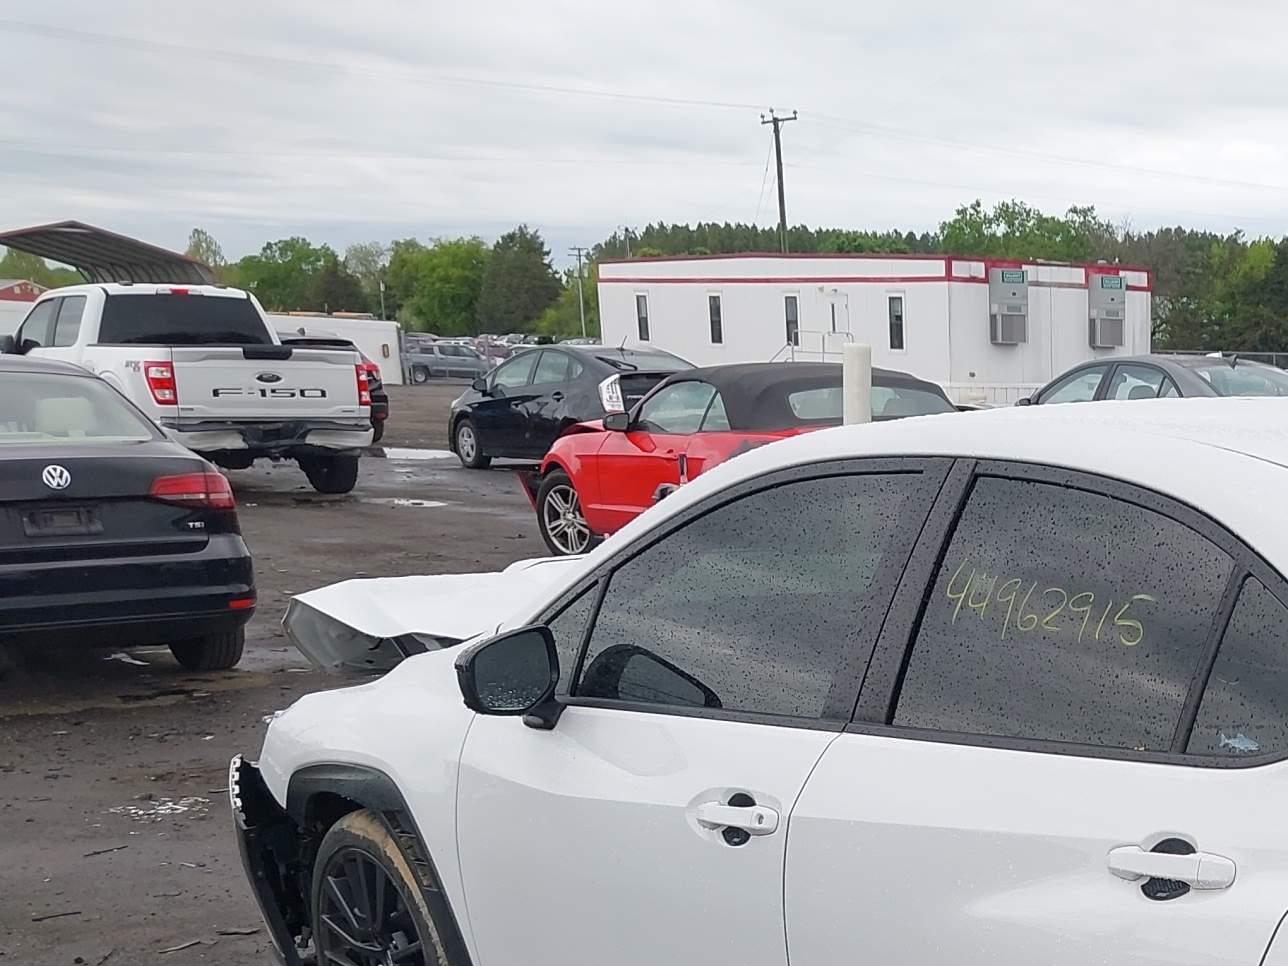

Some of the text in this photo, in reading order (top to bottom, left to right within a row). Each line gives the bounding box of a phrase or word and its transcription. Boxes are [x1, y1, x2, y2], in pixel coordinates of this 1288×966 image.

[212, 388, 327, 398] F-150
[42, 464, 71, 490] VW
[946, 557, 1155, 646] 44962915
